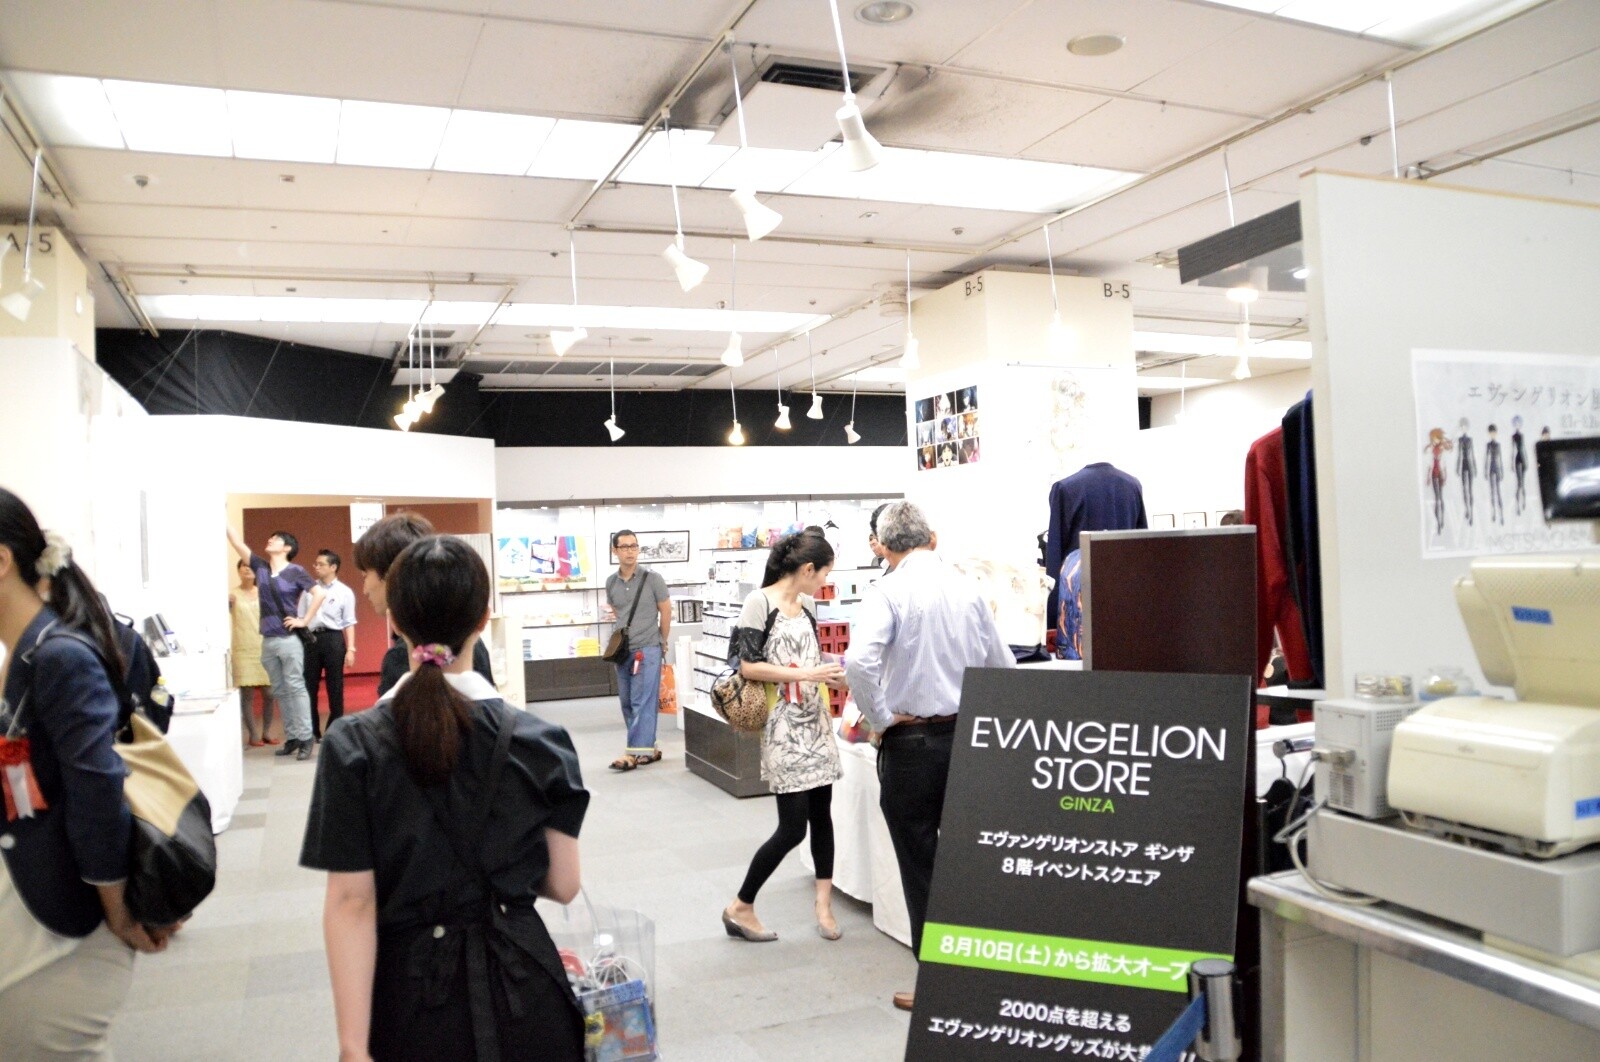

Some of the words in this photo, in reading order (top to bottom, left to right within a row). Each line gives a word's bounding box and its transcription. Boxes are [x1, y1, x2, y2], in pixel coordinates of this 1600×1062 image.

[965, 277, 983, 296] B-5
[1104, 283, 1130, 299] B-5
[971, 717, 1227, 760] EVANGELION
[1032, 756, 1152, 795] STORE
[1060, 796, 1115, 813] GINZA
[978, 831, 1139, 858] エヴァンゲリオンストア
[1144, 843, 1195, 863] ギンザ
[1002, 857, 1161, 886] 8階イベントスクエア
[940, 935, 1190, 981] 8月10日(土)から拡大オープ
[1000, 999, 1132, 1033] 2000点を超える
